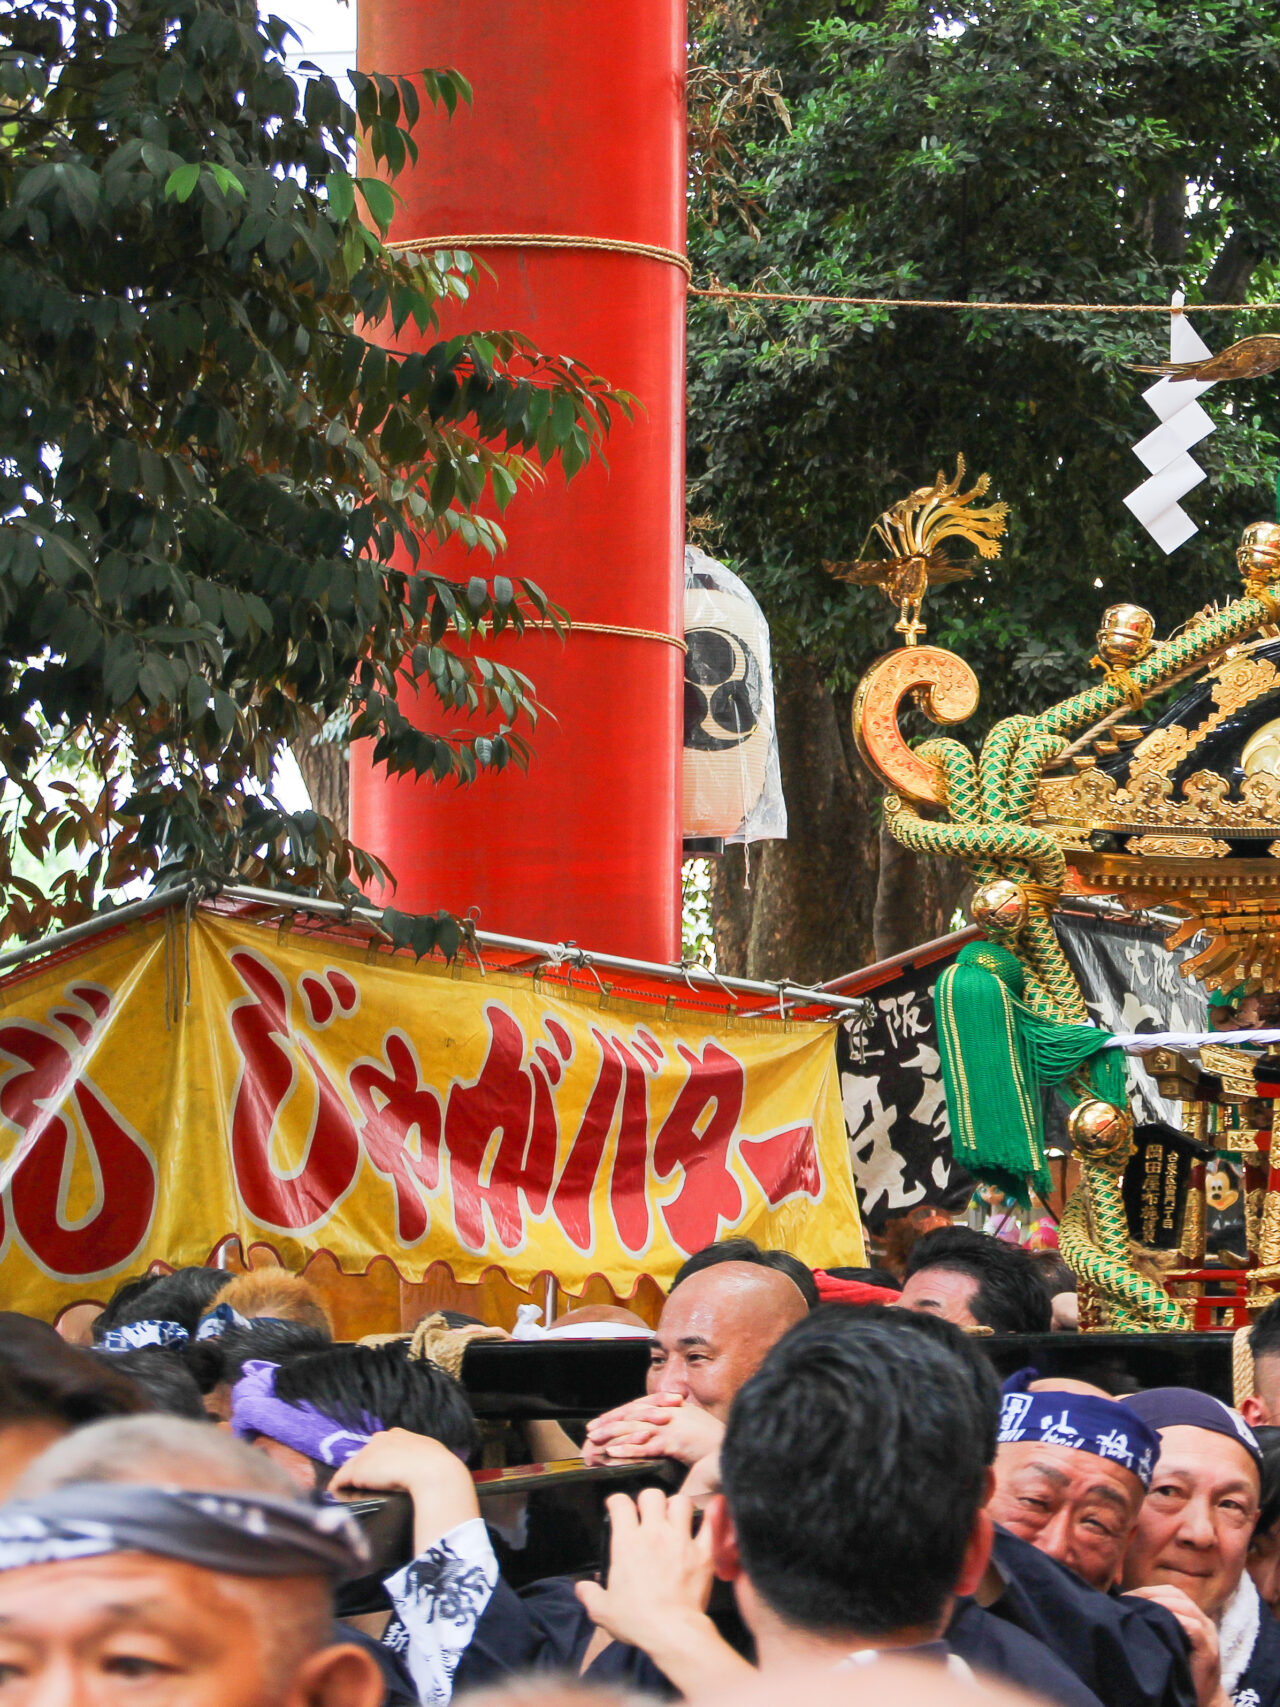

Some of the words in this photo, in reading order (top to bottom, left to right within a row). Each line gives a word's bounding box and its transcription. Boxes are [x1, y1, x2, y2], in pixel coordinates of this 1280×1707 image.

[230, 945, 824, 1258] じゃがバター
